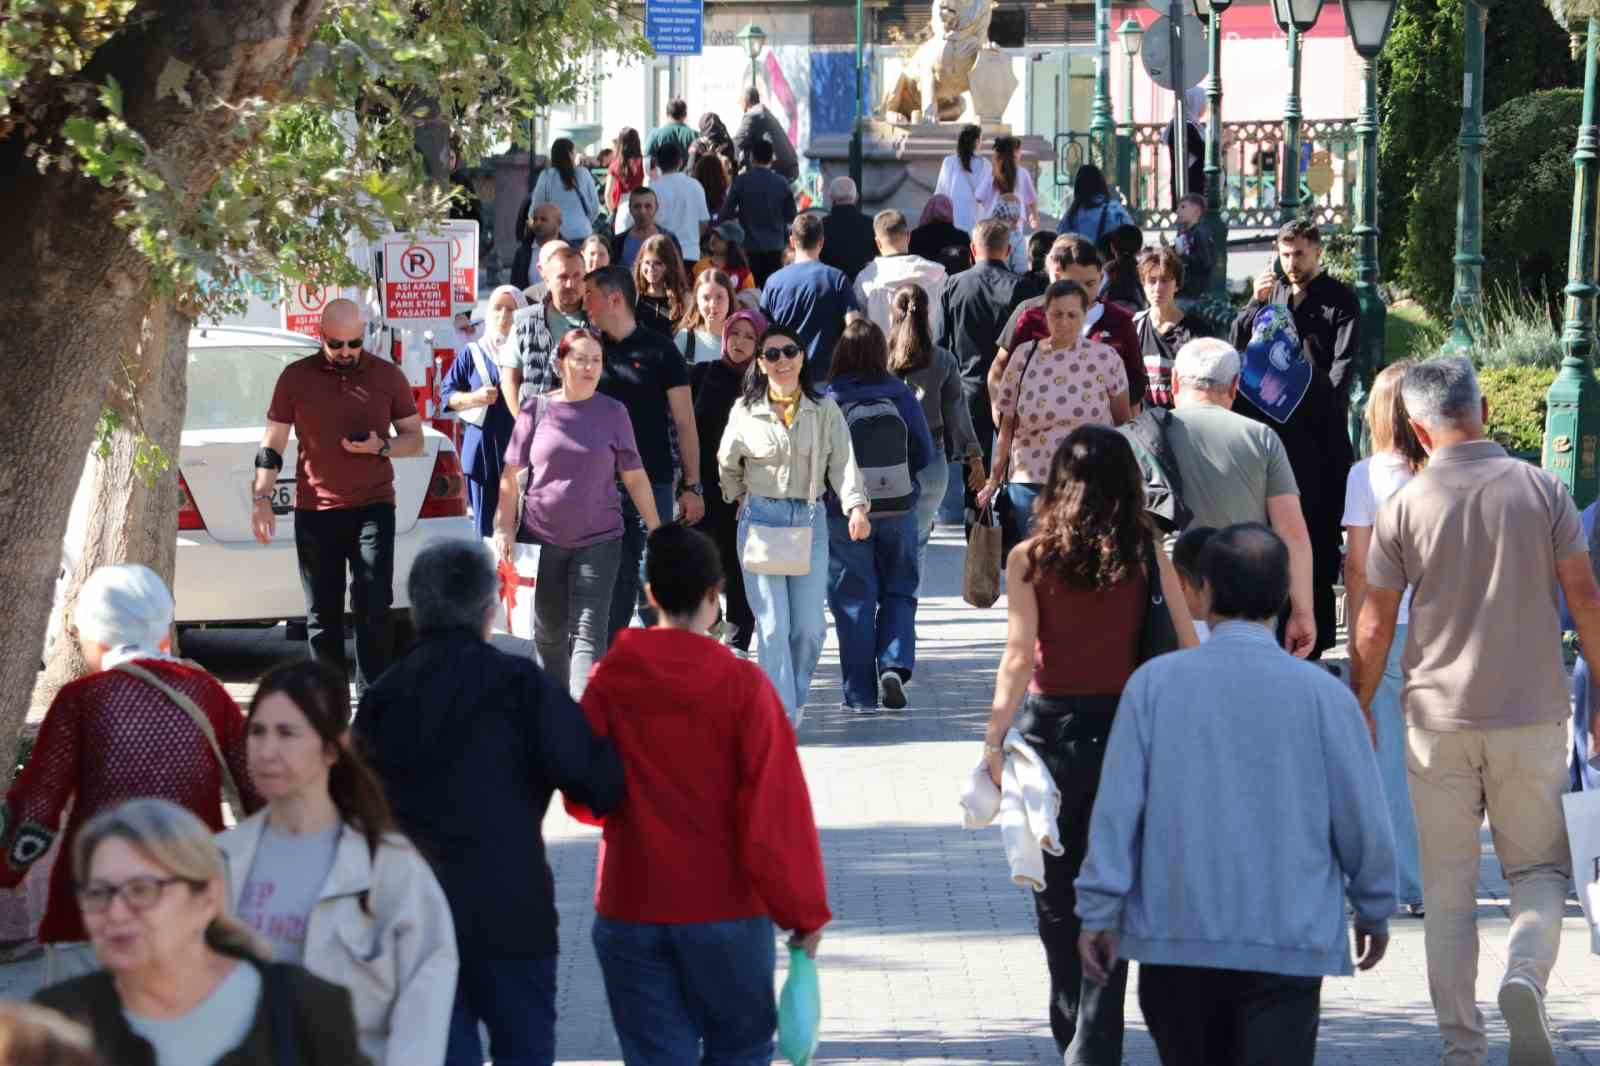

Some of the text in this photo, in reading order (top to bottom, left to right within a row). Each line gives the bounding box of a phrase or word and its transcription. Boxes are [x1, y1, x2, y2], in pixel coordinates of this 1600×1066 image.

[395, 291, 418, 299] PARK
[390, 300, 447, 308] PARK ETMEK
[396, 308, 441, 317] YASAKTIR
[271, 486, 291, 505] 26
